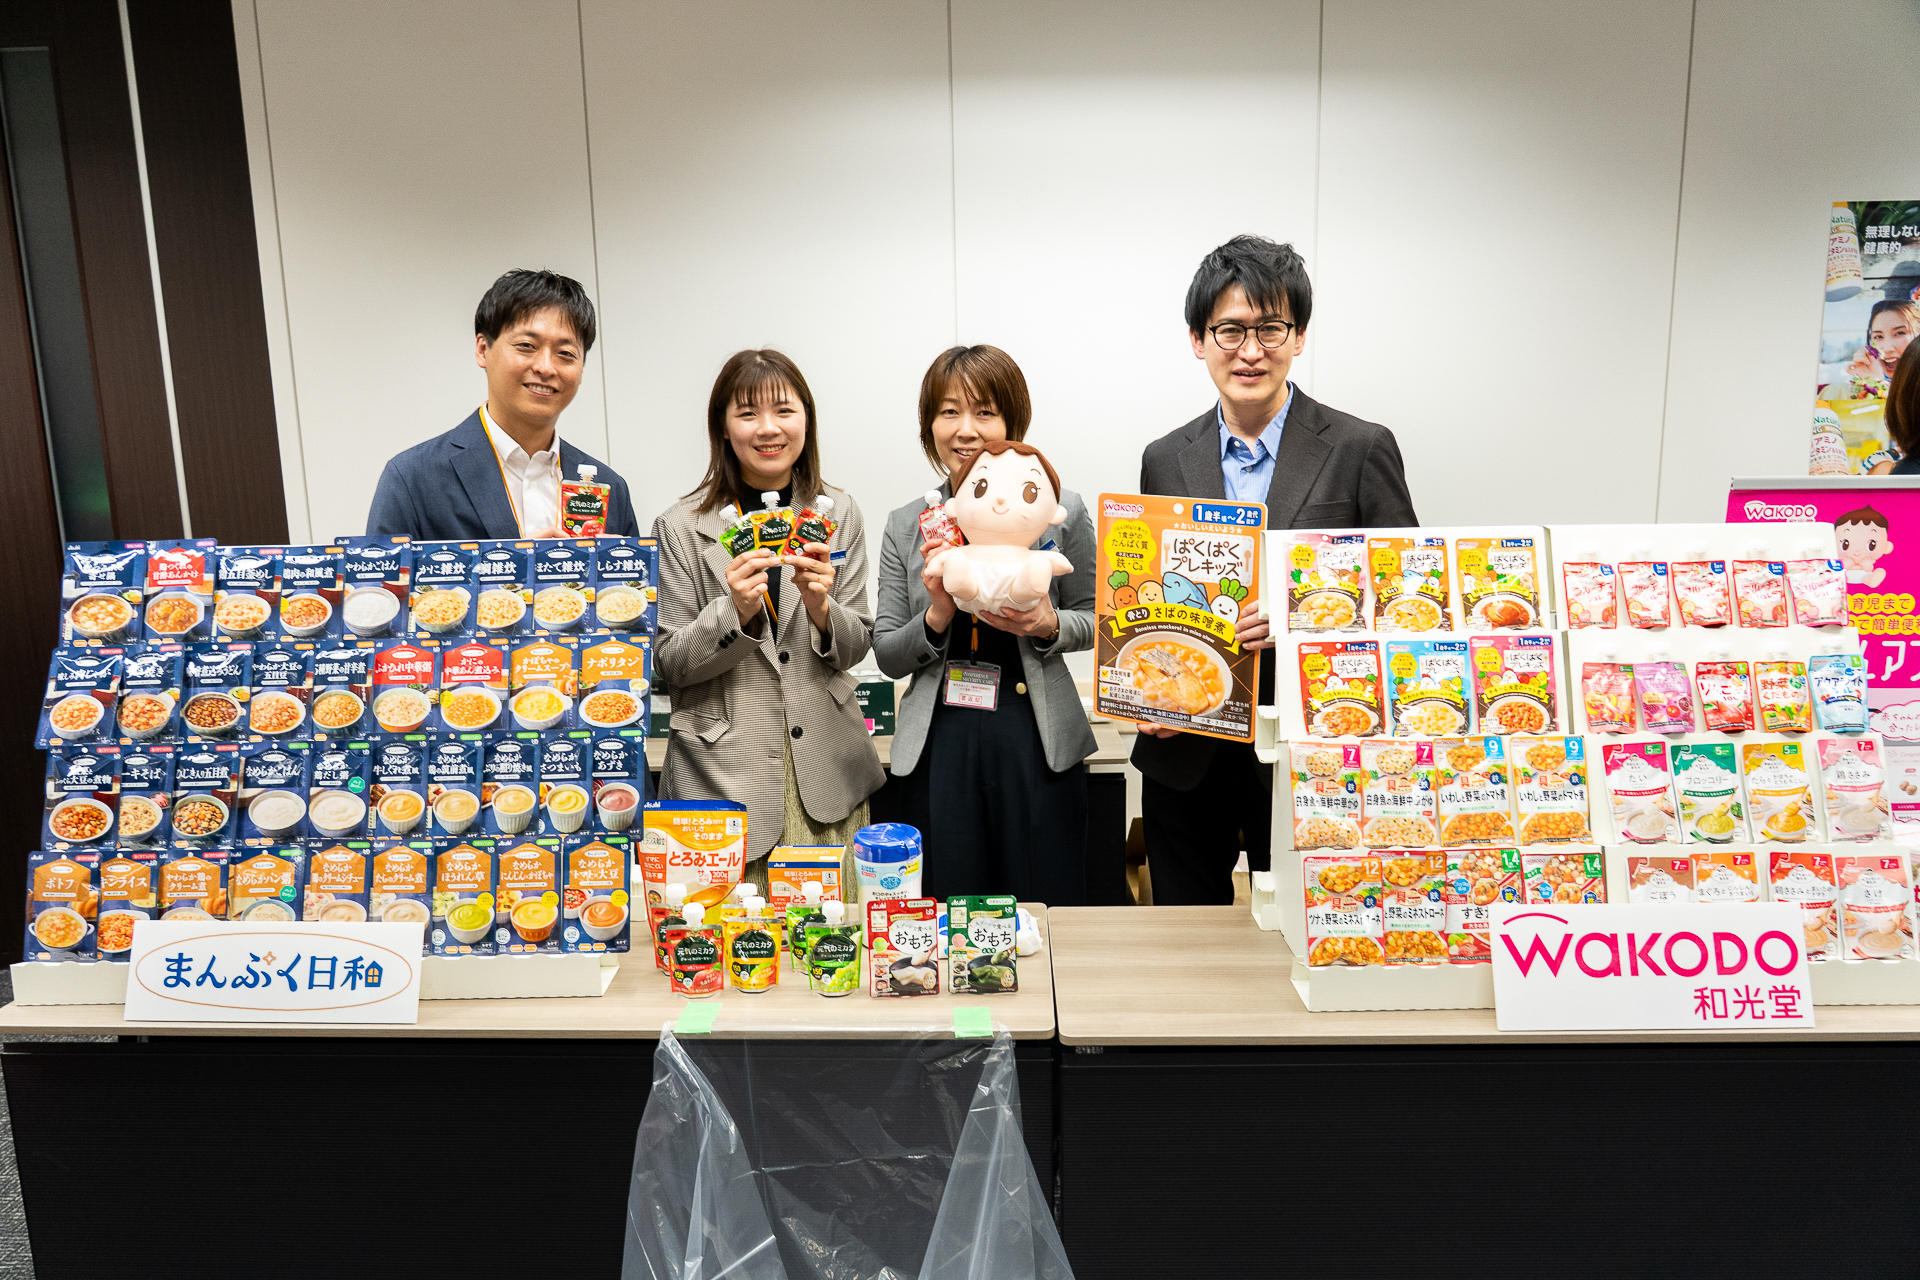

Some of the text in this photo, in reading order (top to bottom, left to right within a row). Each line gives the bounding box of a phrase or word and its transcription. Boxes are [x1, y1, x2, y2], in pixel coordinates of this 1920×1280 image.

[1829, 236, 1850, 246] アミノ
[1863, 241, 1907, 255] 健康的。
[1814, 436, 1837, 446] アミノ
[569, 500, 603, 508] 元気のミカタ
[1111, 539, 1149, 550] たんぱく質
[1173, 538, 1240, 560] ぱくぱく
[1493, 554, 1526, 563] ぱくぱく
[345, 560, 399, 572] やわらかごはん
[418, 562, 467, 575] かに雑炊
[597, 560, 646, 572] しらす雑炊
[1171, 556, 1243, 577] プレキッズ
[153, 570, 199, 580] 甘酢あんかけ
[1852, 597, 1910, 611] 育児まで
[1127, 609, 1148, 620] 骨とり
[1154, 606, 1227, 635] さばの味噌煮
[1134, 624, 1157, 633] Boneless
[460, 657, 484, 666] かにの
[522, 657, 560, 665] かぼちゃの
[1510, 653, 1543, 661] ぱくぱく
[252, 662, 303, 671] やわらか大豆の
[586, 657, 638, 669] ナポリタン
[1337, 658, 1372, 667] ぱくぱく
[1425, 658, 1460, 667] ぱくぱく
[444, 666, 501, 675] 中華あん煮込み
[515, 664, 568, 673] クリームスープ
[1337, 666, 1374, 674] プレキッズ
[1760, 677, 1789, 690] 野菜
[1488, 740, 1499, 752] 9
[1569, 740, 1579, 753] 9
[1647, 745, 1653, 754] 5
[1715, 746, 1722, 756] 5
[1784, 745, 1790, 754] 5
[1858, 741, 1866, 751] 7
[494, 752, 523, 762] なめらか
[543, 752, 578, 762] なめらか
[593, 750, 629, 760] なめらか
[1347, 748, 1356, 761] 7
[1420, 745, 1430, 759] 7
[382, 755, 411, 764] なめらか
[436, 753, 465, 763] なめらか
[245, 764, 300, 777] なめらかごはん
[539, 761, 582, 772] さつまいも
[597, 760, 624, 771] あずき
[1629, 774, 1648, 783] たい
[1685, 776, 1729, 785] ブロッコリー
[1440, 790, 1507, 804] いわしと野菜のトマト煮
[1519, 790, 1586, 803] いわしと野菜のトマト煮
[693, 832, 723, 840] そのまま
[578, 859, 616, 869] なめらか
[669, 851, 741, 867] とろみエール
[1427, 855, 1444, 869] 12
[1734, 855, 1742, 865] 7
[1813, 856, 1820, 865] 7
[1881, 859, 1889, 869] 7
[322, 863, 353, 873] なめらか
[384, 863, 414, 873] なめらか
[445, 860, 482, 871] なめらか
[512, 860, 542, 870] なめらか
[1363, 861, 1380, 875] 12
[1673, 860, 1681, 870] 7
[165, 872, 212, 882] やわらか鶏の
[235, 873, 292, 885] なめらかパン粥
[375, 873, 425, 884] たらのクリーム煮
[441, 871, 485, 882] ほうれん草
[501, 870, 554, 881] にんじん×かぼちゃ
[573, 869, 619, 880] トマト×大豆
[45, 878, 74, 890] ポトフ
[168, 881, 207, 891] クリーム煮
[1650, 890, 1676, 900] ごぼう
[1698, 887, 1726, 897] まぐろと
[1863, 889, 1883, 899] さけ
[1308, 913, 1382, 926] ツナと野菜のミネスーネ
[895, 931, 933, 949] おもち
[974, 928, 1012, 947] おもち
[734, 941, 773, 949] 元気のミカタ
[817, 945, 855, 953] 元気のミカタ
[677, 947, 715, 956] 元気のミカタ
[1693, 984, 1804, 1021] 和光堂
